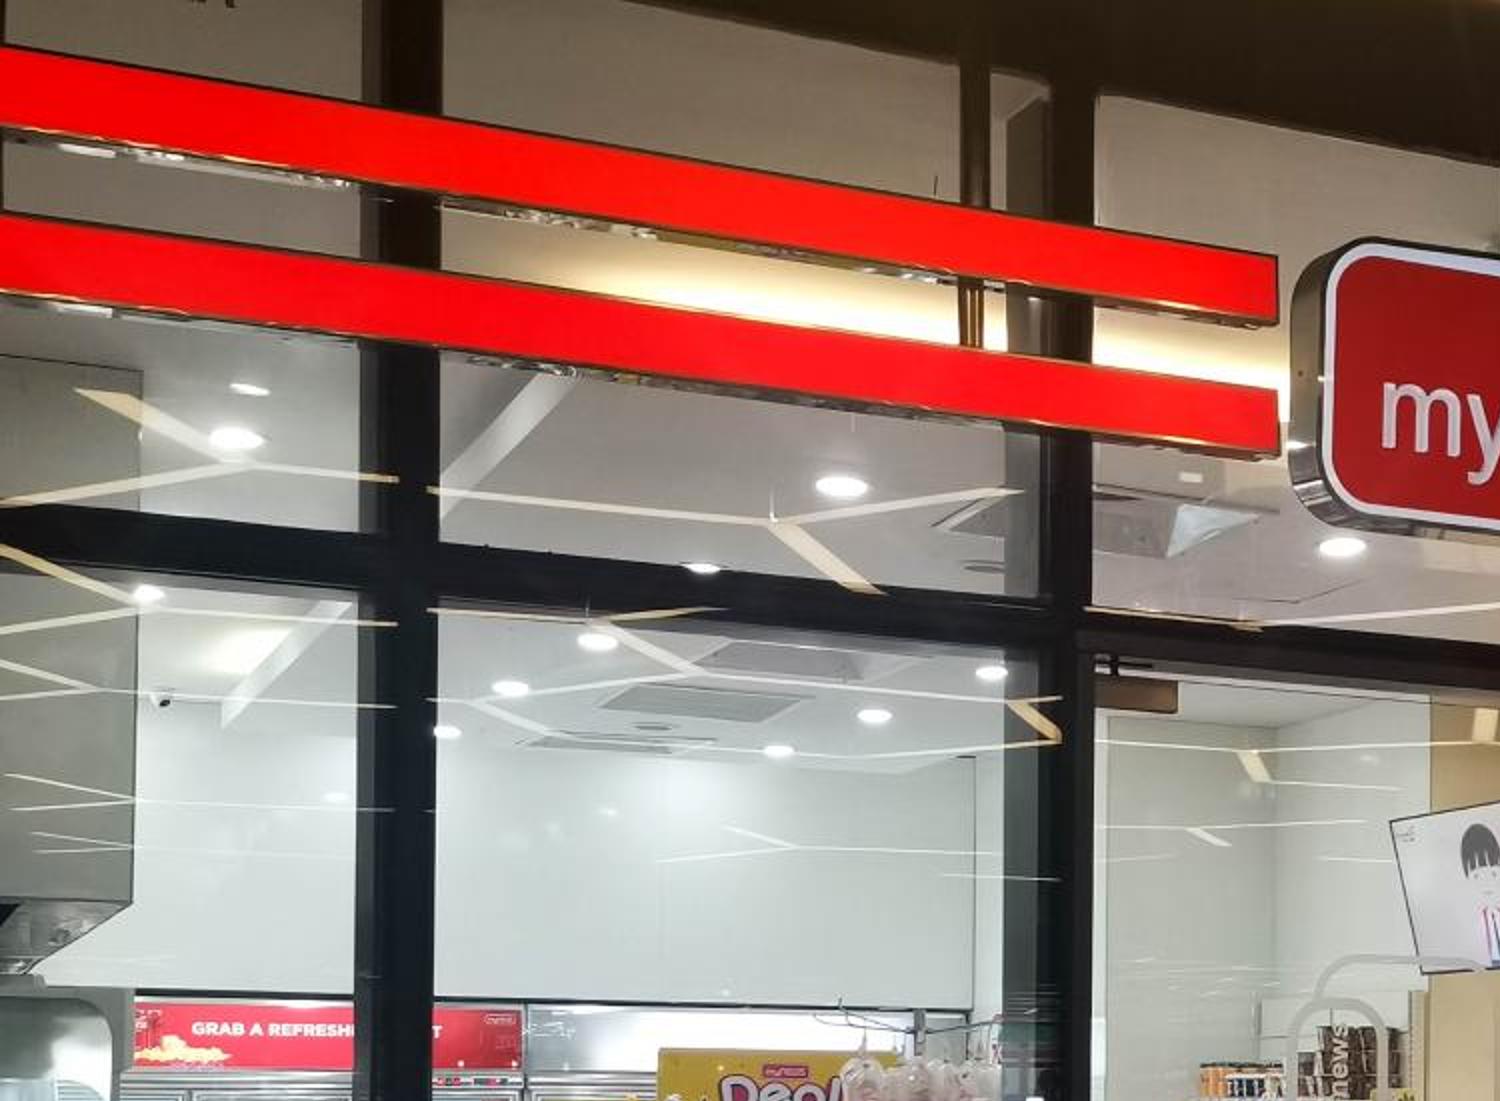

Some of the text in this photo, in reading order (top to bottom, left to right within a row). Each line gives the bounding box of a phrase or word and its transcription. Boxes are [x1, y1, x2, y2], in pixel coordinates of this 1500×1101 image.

[191, 1021, 355, 1038] GRAB A REFRESHI
[1330, 1022, 1349, 1101] news
